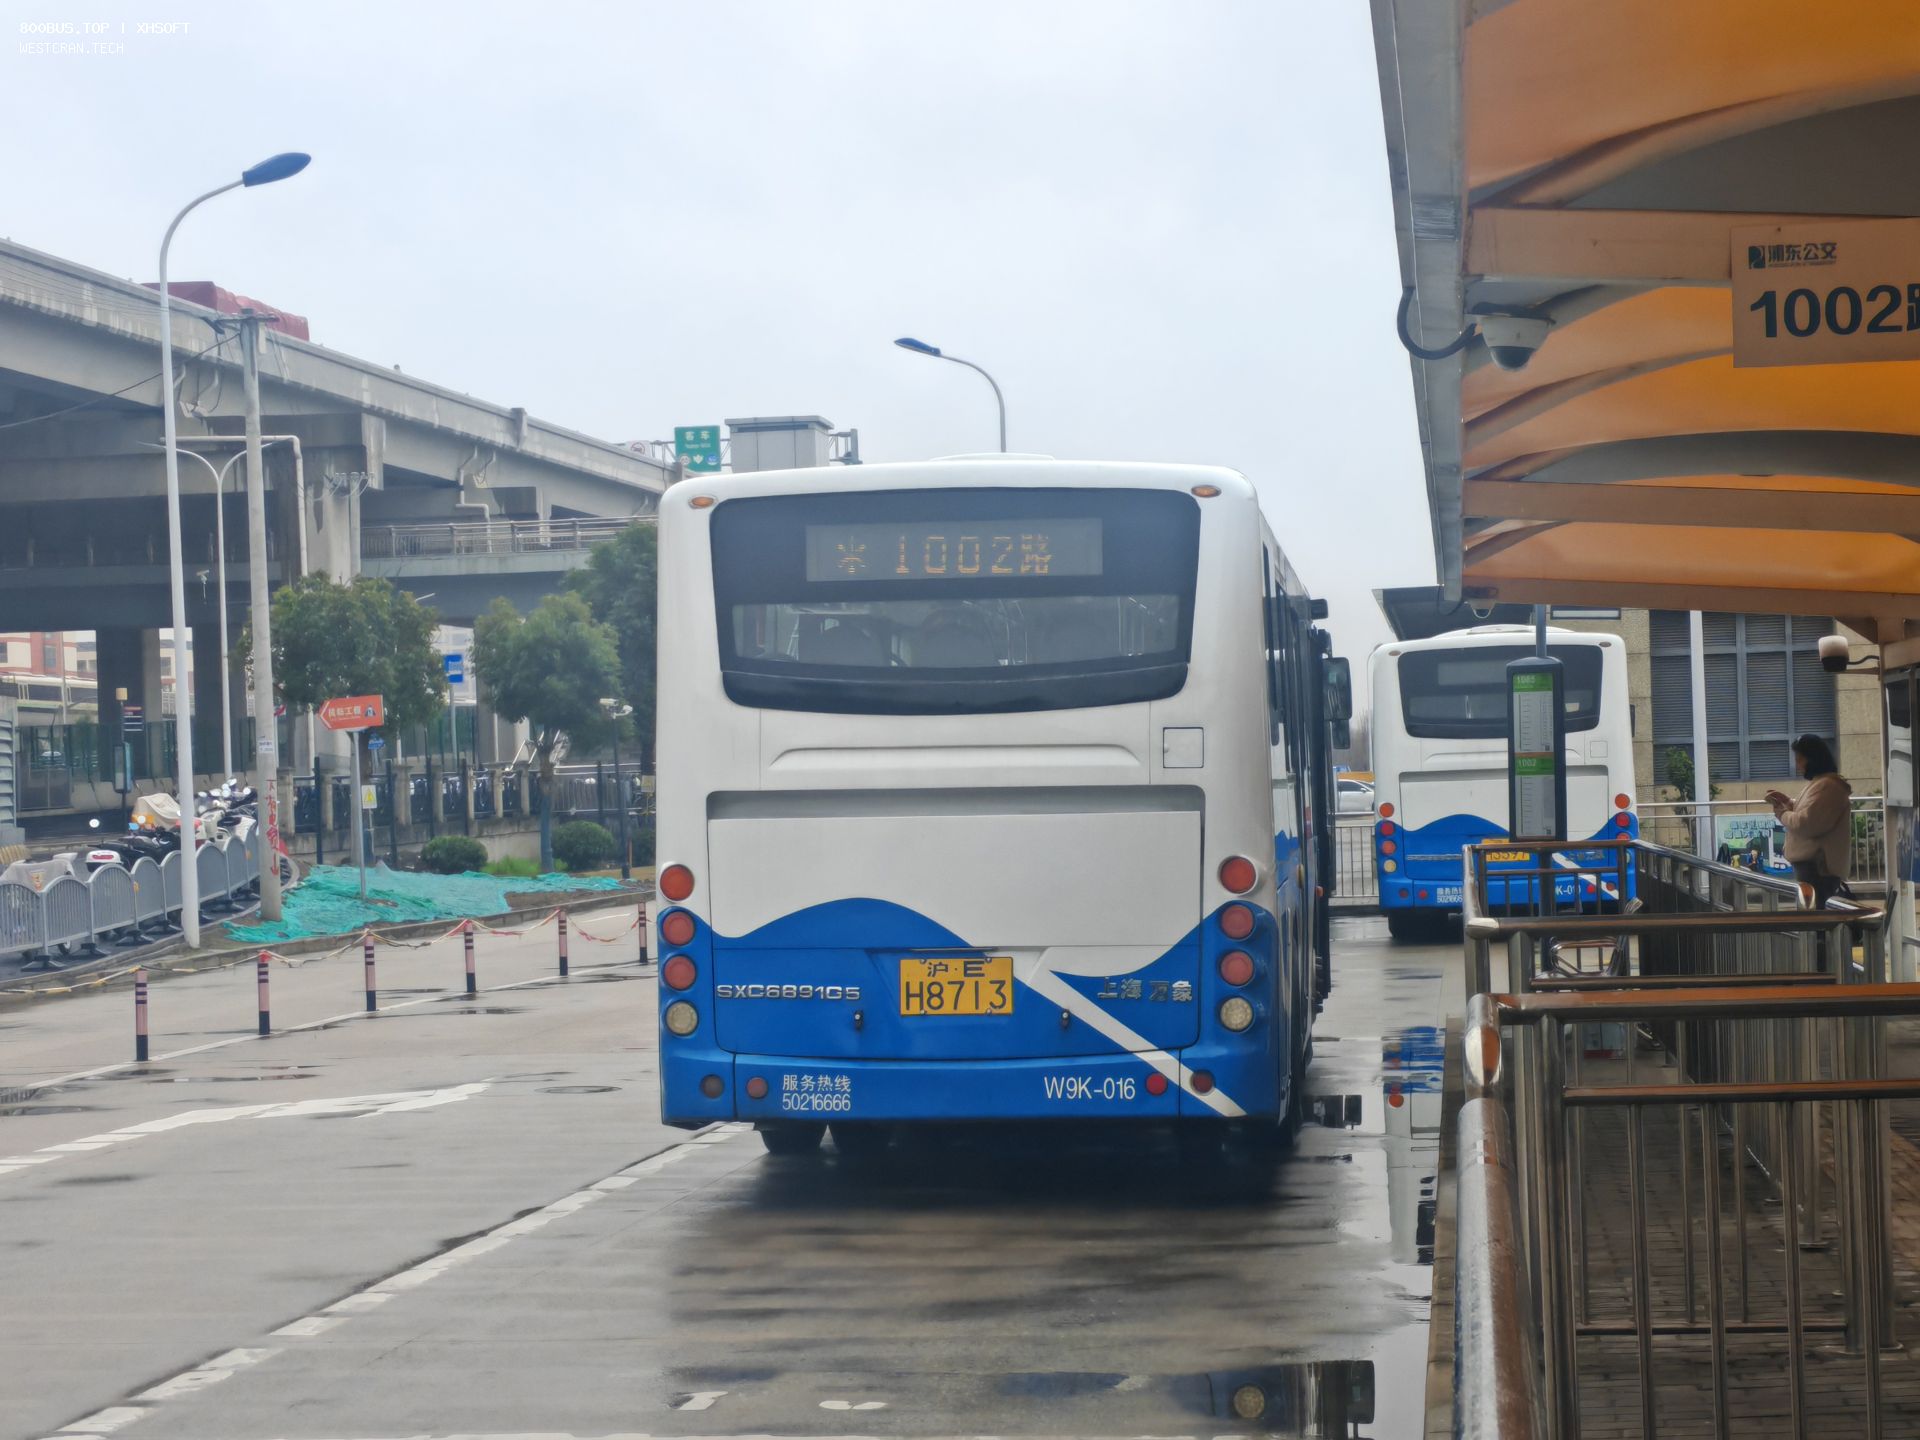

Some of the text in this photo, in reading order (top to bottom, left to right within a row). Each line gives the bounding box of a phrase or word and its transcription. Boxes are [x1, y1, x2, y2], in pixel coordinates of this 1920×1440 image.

[716, 984, 860, 1000] SXC6891G5
[904, 980, 1007, 1011] H8713
[782, 1074, 852, 1093] 服务热线
[1043, 1076, 1136, 1099] W9K-016
[782, 1092, 852, 1111] 50216666
